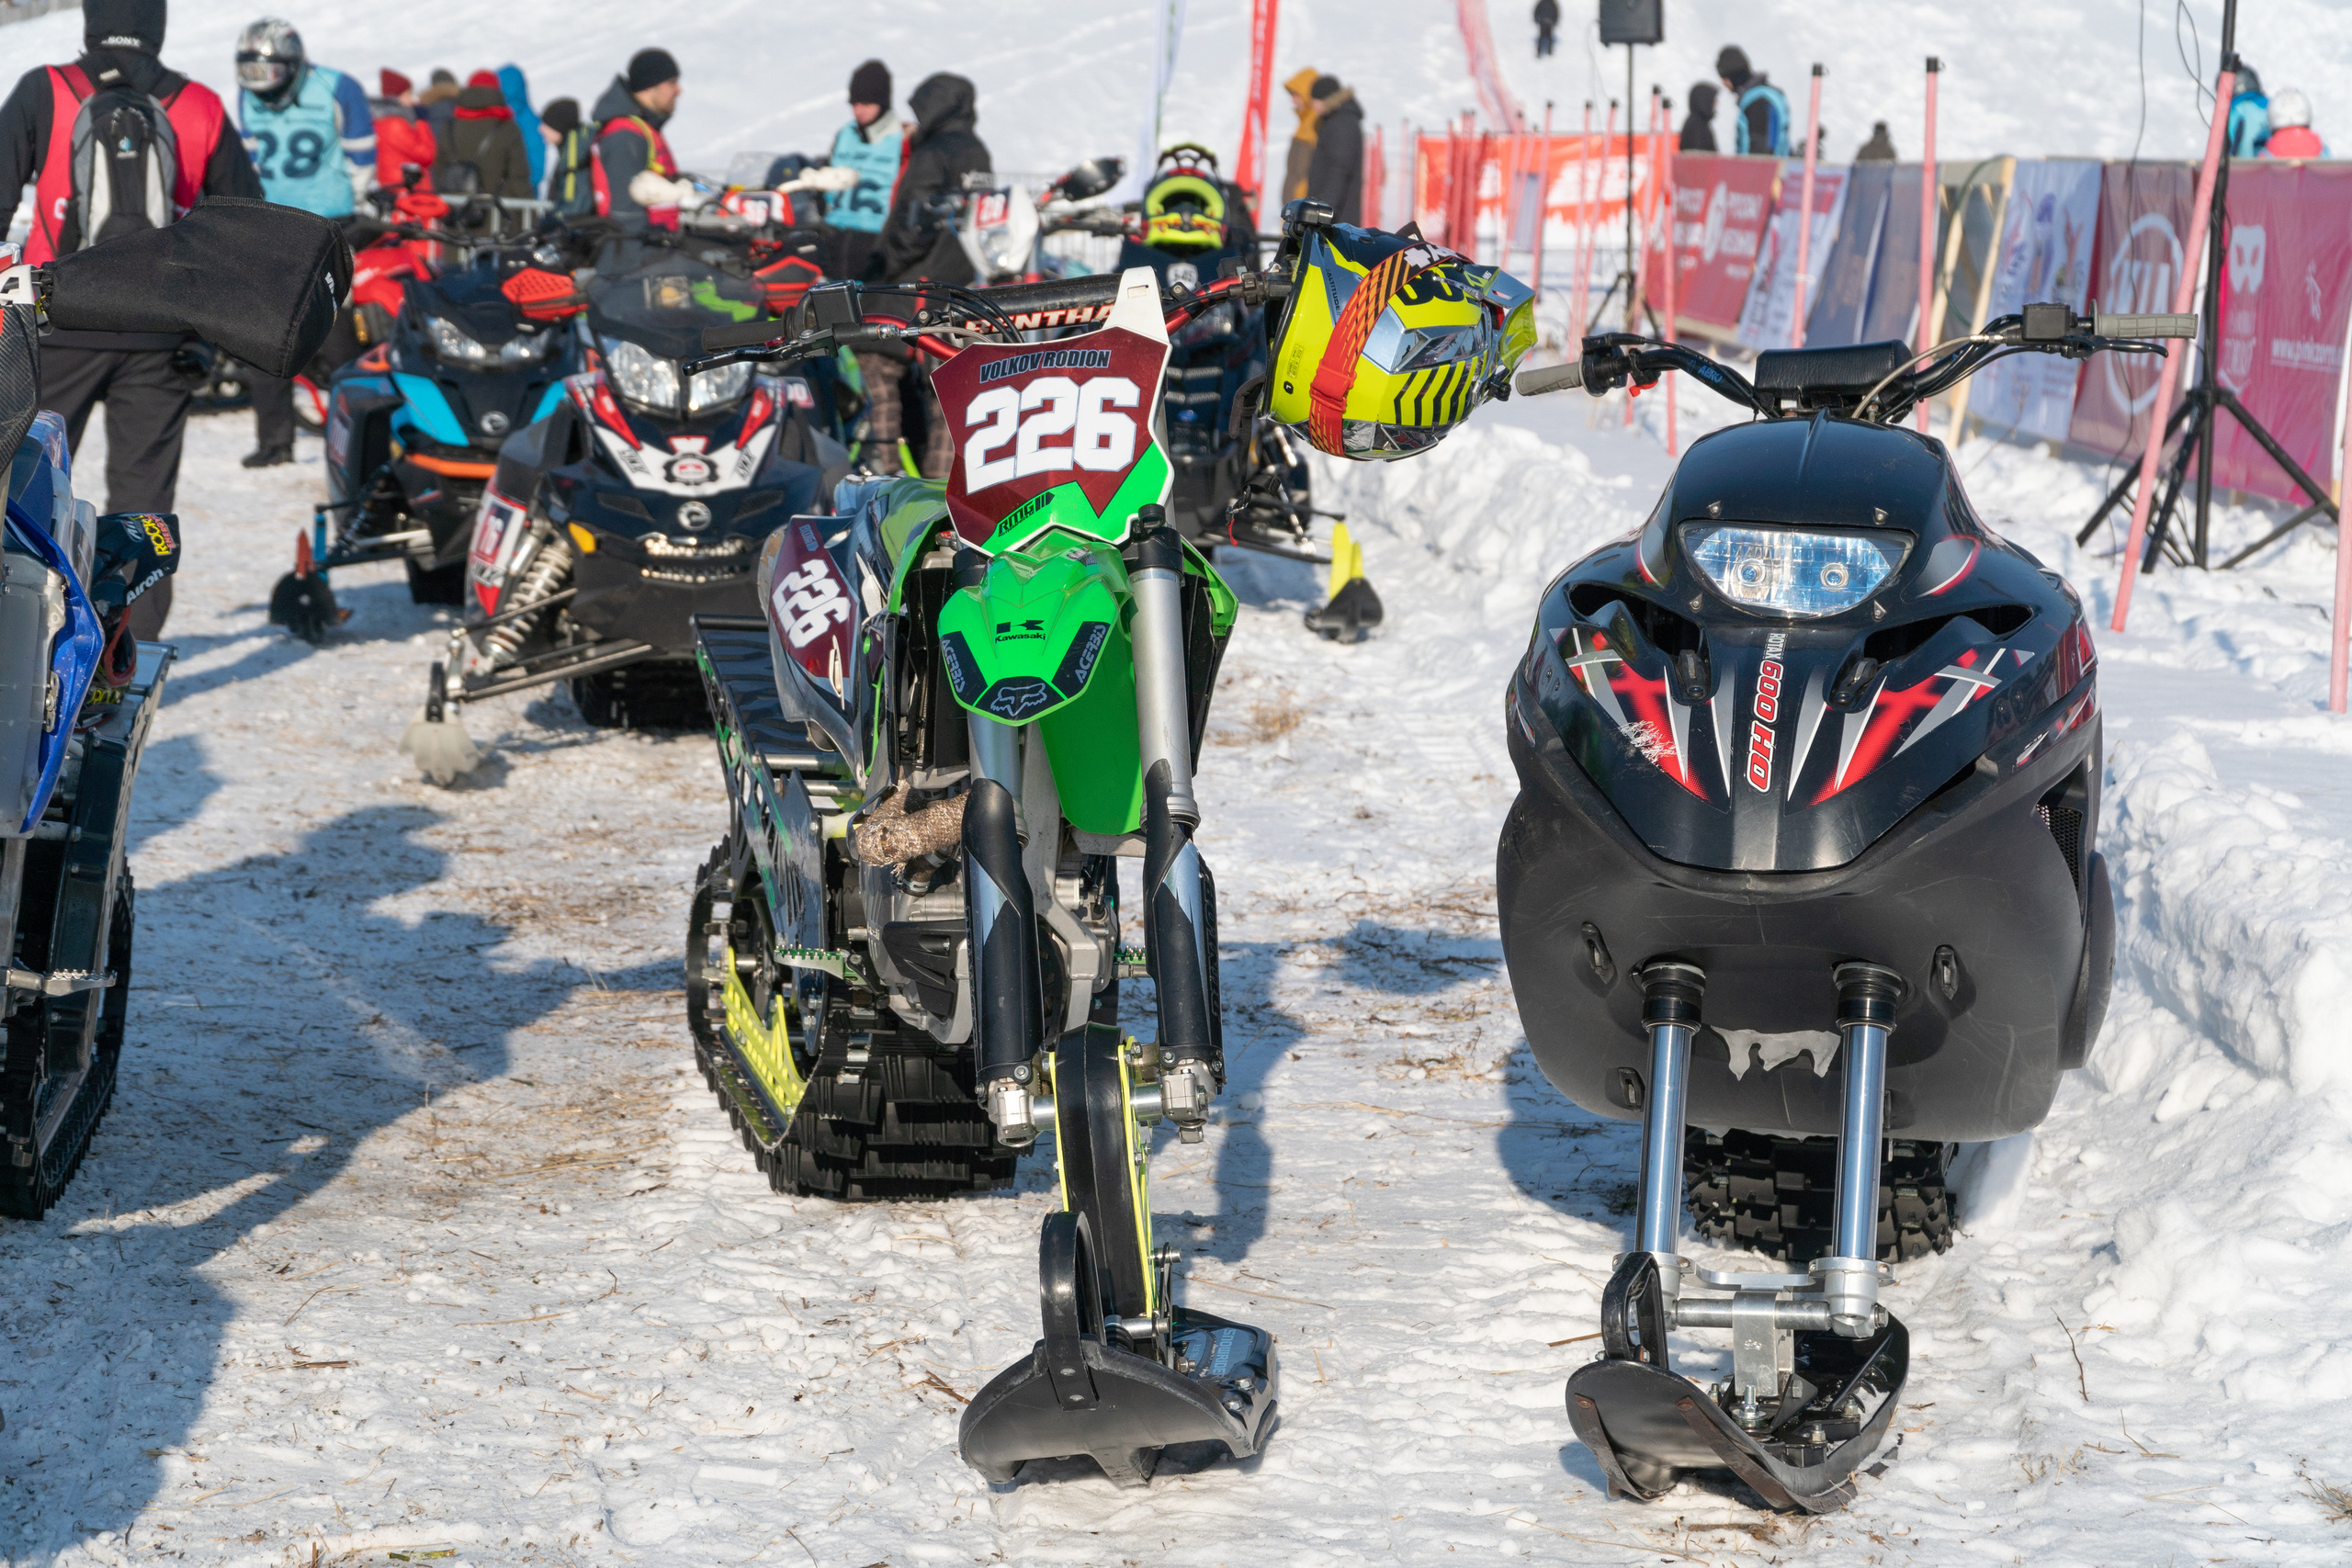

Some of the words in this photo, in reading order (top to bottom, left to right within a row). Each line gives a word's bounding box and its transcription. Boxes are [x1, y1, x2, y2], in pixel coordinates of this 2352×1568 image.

[107, 36, 141, 48] SONY
[254, 130, 324, 179] 28
[979, 351, 1044, 384] VOLKOV
[1042, 349, 1111, 368] RODION
[1698, 365, 1723, 383] AERO
[965, 377, 1140, 495] 226
[772, 558, 852, 649] 226
[995, 633, 1046, 644] Kawasaki
[1075, 625, 1106, 684] ACERBIS
[1763, 633, 1786, 660] ROTAX
[942, 639, 966, 693] ACERBIS
[1754, 660, 1784, 723] 600
[1747, 720, 1775, 793] HO
